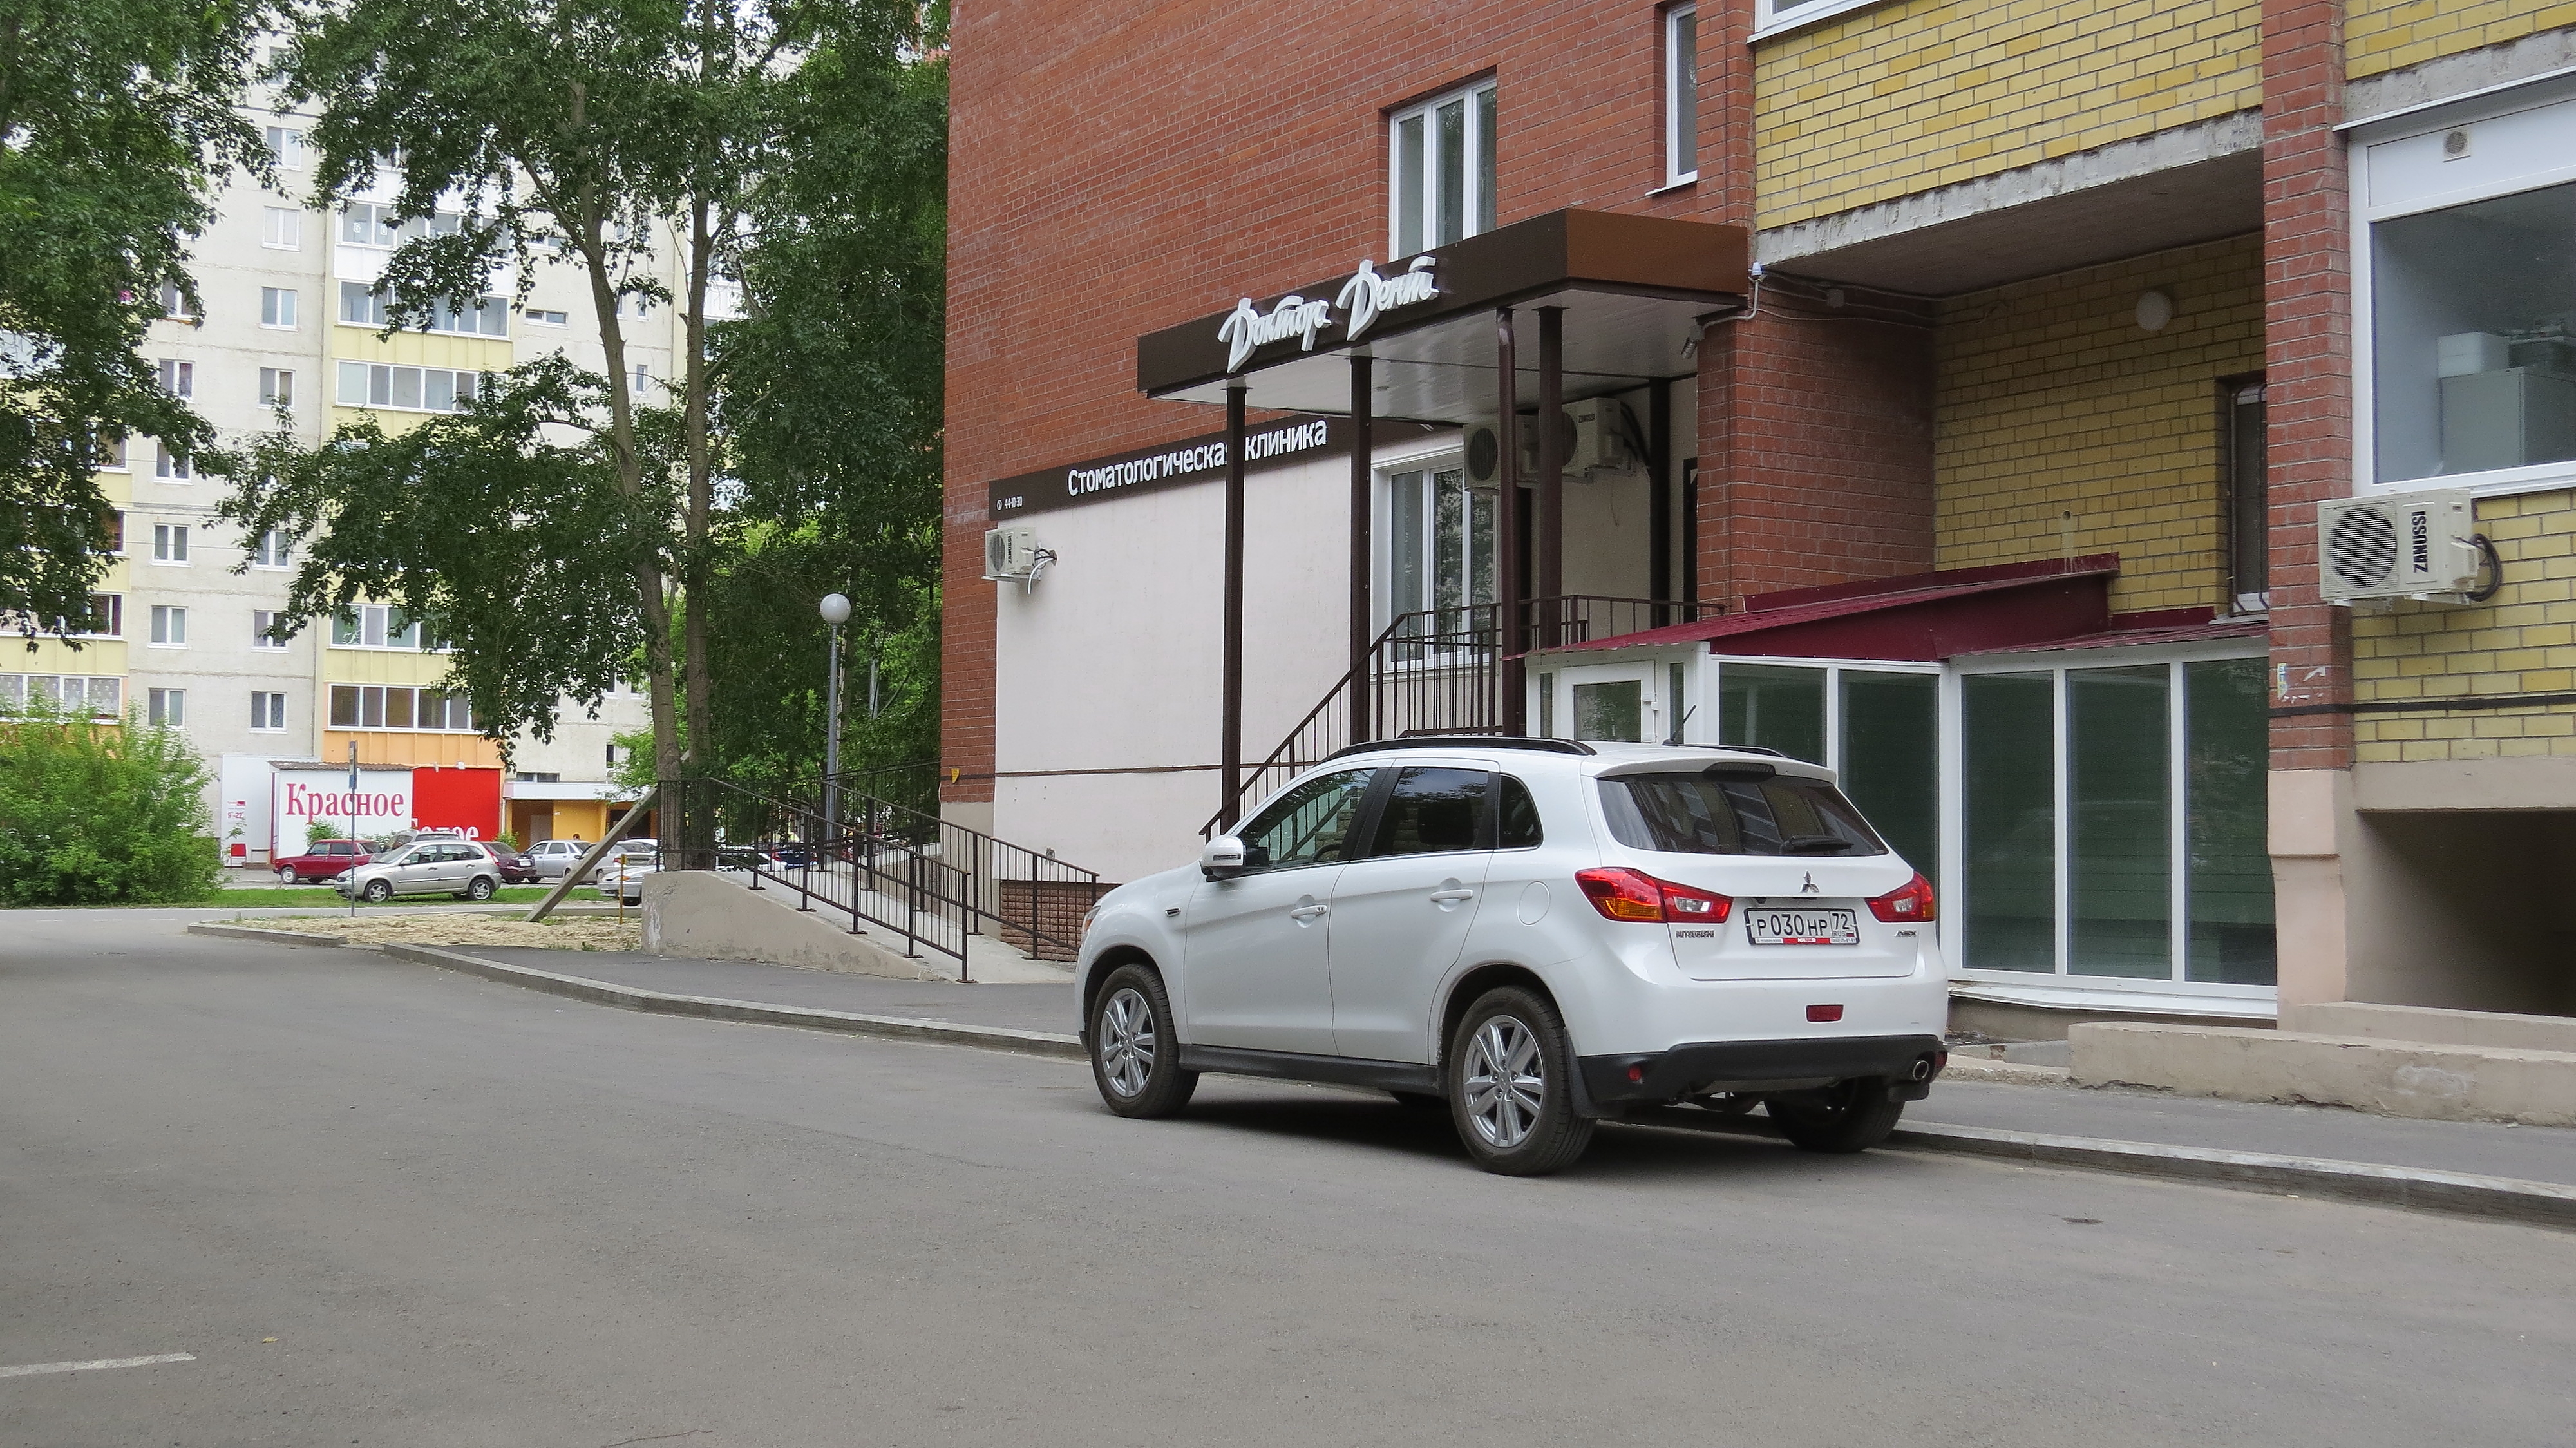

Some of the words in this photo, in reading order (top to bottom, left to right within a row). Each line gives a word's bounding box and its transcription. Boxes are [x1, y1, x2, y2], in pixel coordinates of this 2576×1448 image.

[1217, 297, 1332, 374] Доктор
[1335, 256, 1440, 341] Дент
[1068, 441, 1227, 497] Стоматологическа
[1244, 420, 1327, 461] клиника
[1004, 495, 1023, 509] 44-10-30
[2411, 511, 2428, 573] ZANUSSI
[285, 783, 404, 824] Красное
[1832, 913, 1850, 930] 72
